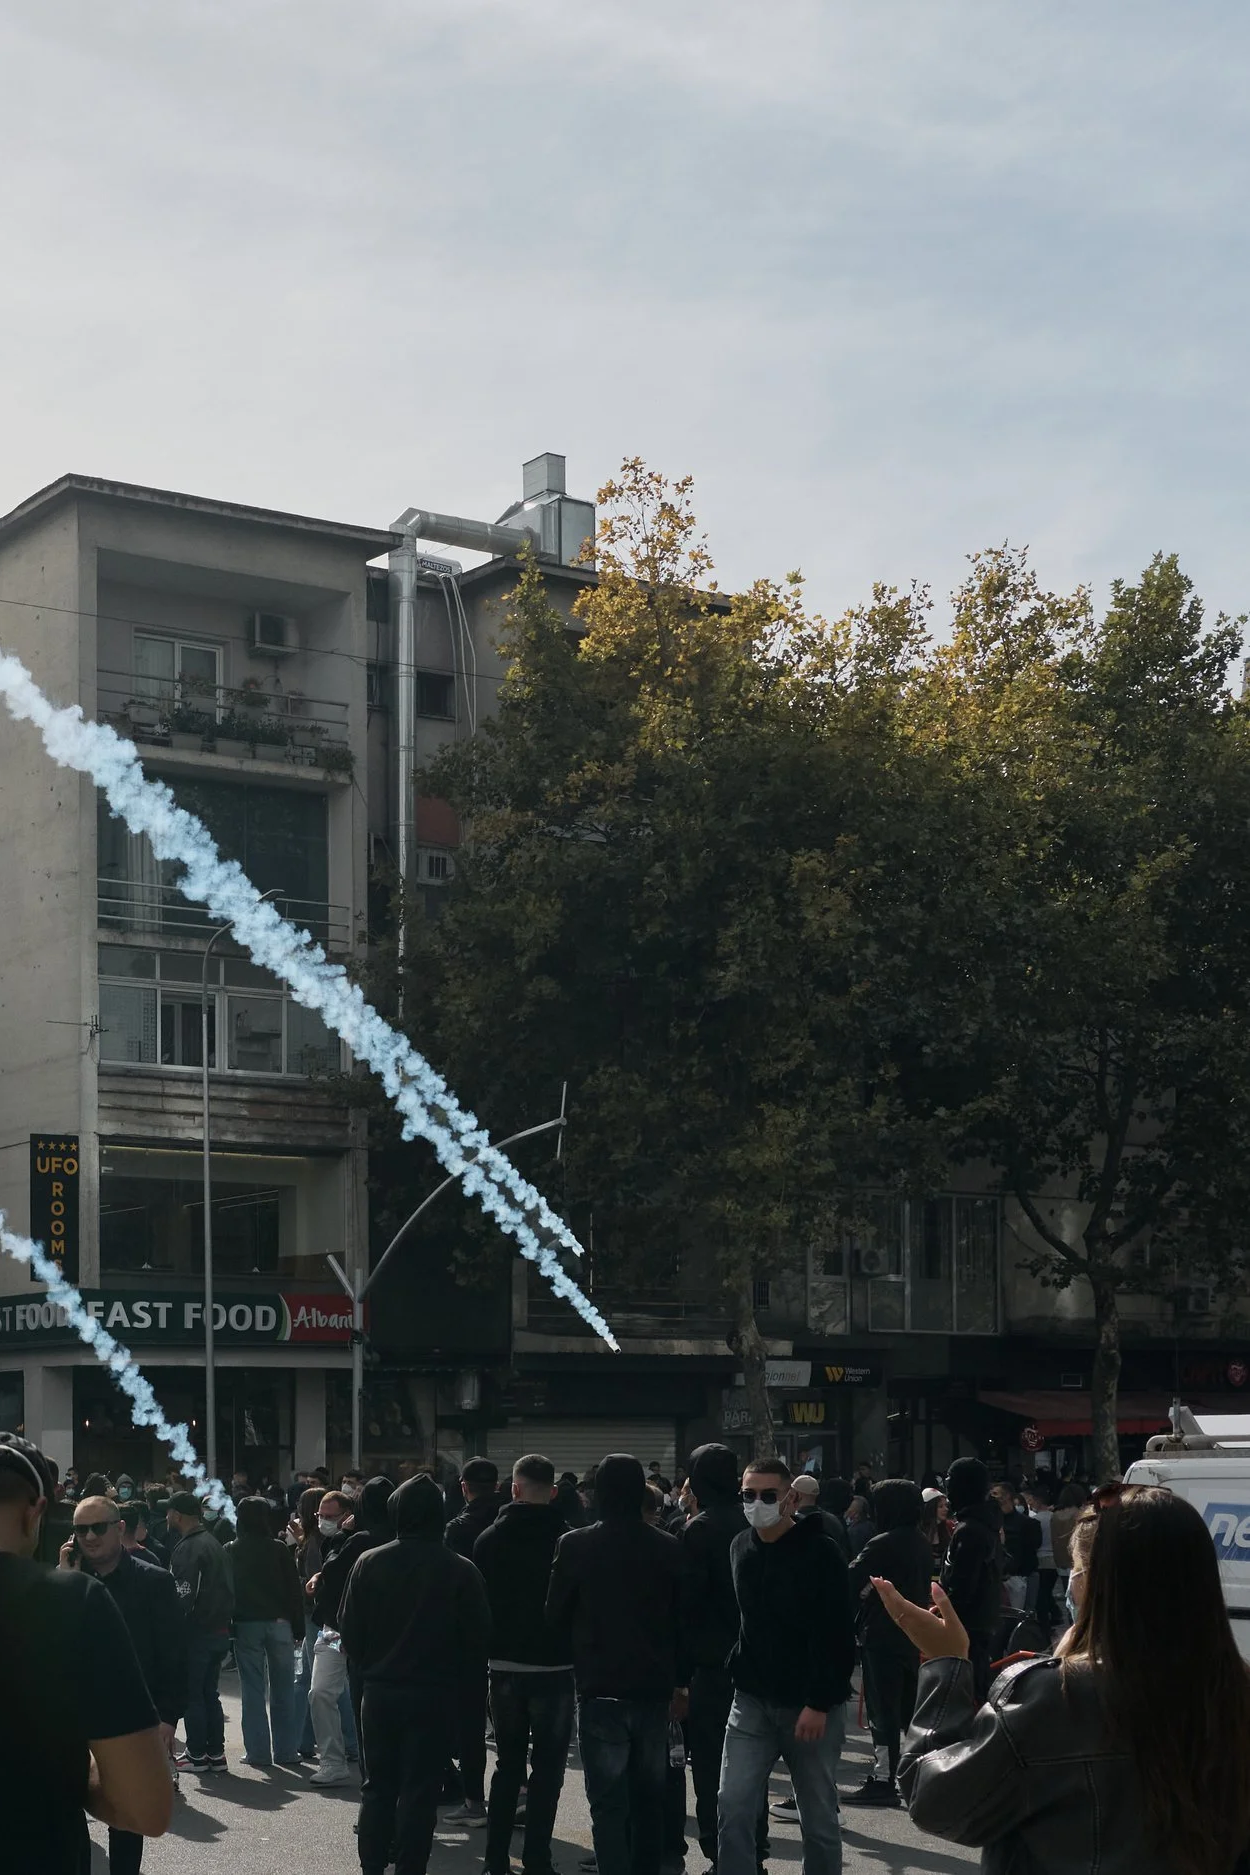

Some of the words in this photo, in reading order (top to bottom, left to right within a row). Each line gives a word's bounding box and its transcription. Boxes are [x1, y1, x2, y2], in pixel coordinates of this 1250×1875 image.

[36, 1156, 79, 1175] UFO
[183, 1302, 277, 1331] FOOD
[845, 1367, 871, 1375] Western
